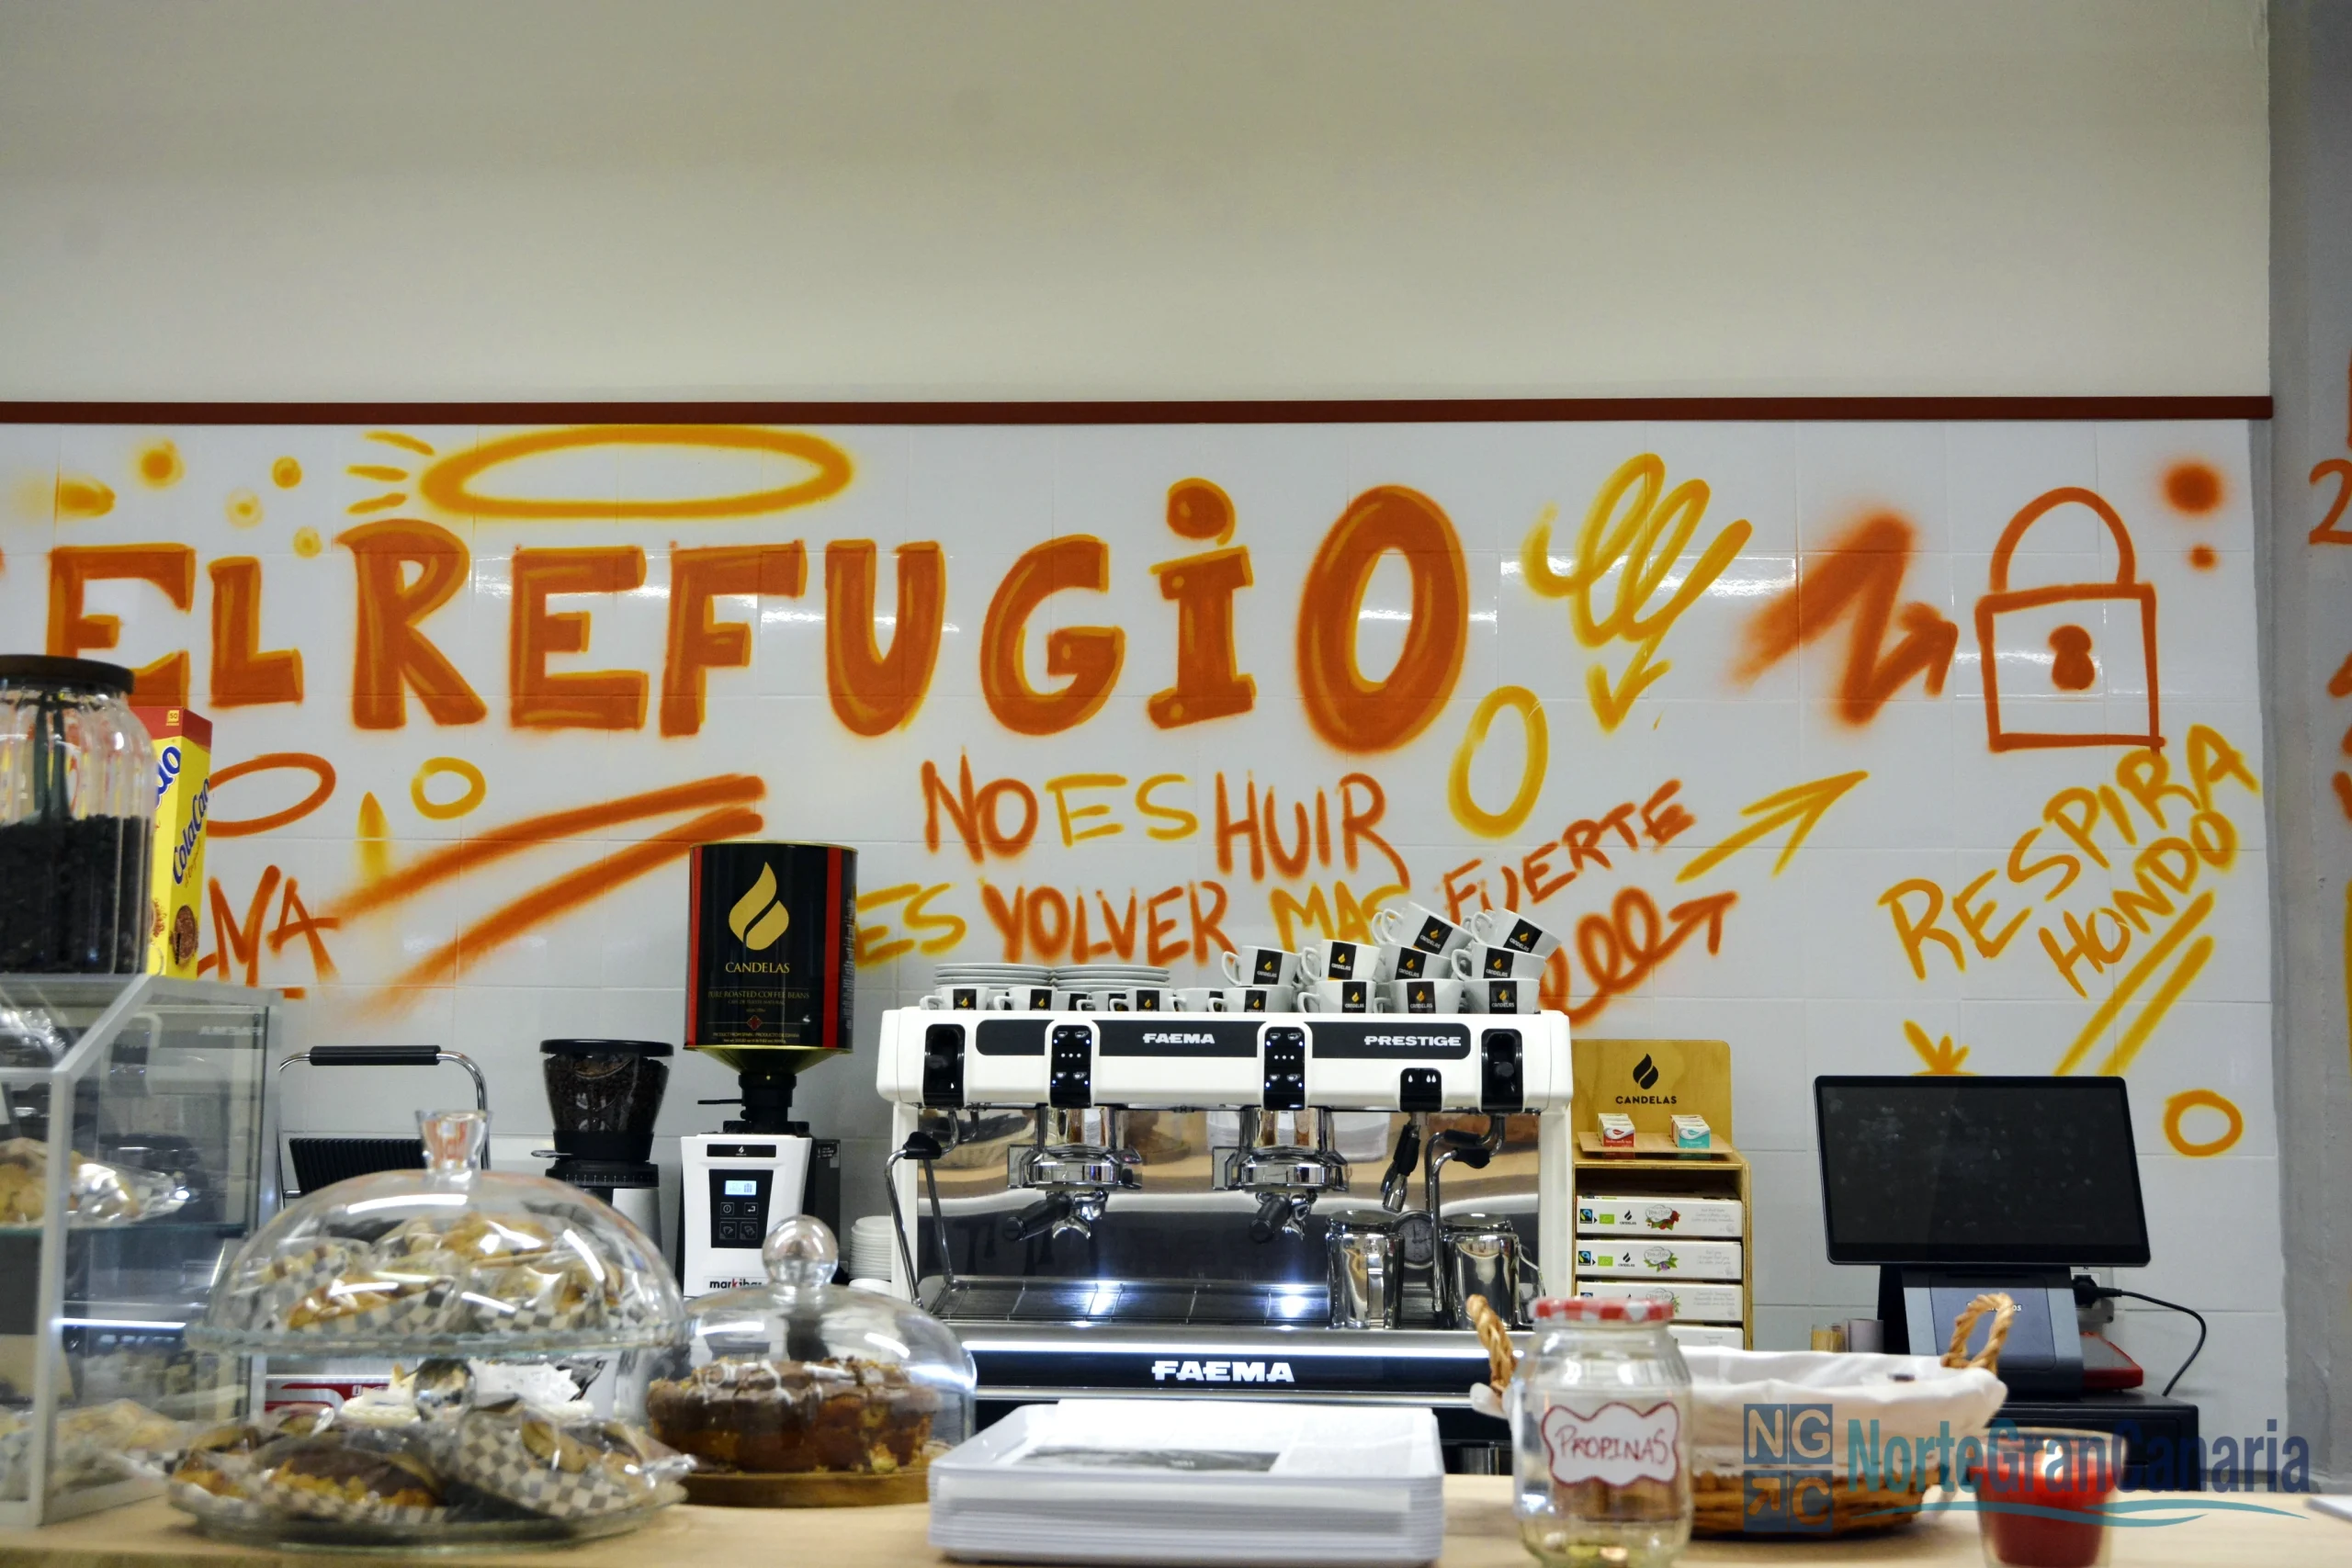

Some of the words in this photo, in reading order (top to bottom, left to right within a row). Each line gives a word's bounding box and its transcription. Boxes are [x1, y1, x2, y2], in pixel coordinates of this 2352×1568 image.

[334, 477, 1470, 753] REFUGIO
[921, 748, 1038, 865] NO
[1045, 773, 1199, 847] ES
[1215, 772, 1410, 889] HUIR
[1877, 724, 2260, 982] RESPIRA
[855, 882, 967, 967] ES
[1442, 777, 1696, 924] FUERTE
[2038, 809, 2239, 999] HONDO
[1419, 934, 1442, 949] CANDELAS
[1509, 937, 1531, 953] CANDELAS
[725, 962, 790, 974] CANDELAS
[1397, 967, 1420, 978] CANDELAS
[1485, 968, 1509, 978] CANDELAS
[1143, 1032, 1215, 1044] FAEMA
[1363, 1035, 1462, 1046] PRESTIGE
[1615, 1096, 1677, 1104] CANDELAS
[1151, 1360, 1295, 1382] FAEMA
[1555, 1425, 1668, 1465] PROPINAS
